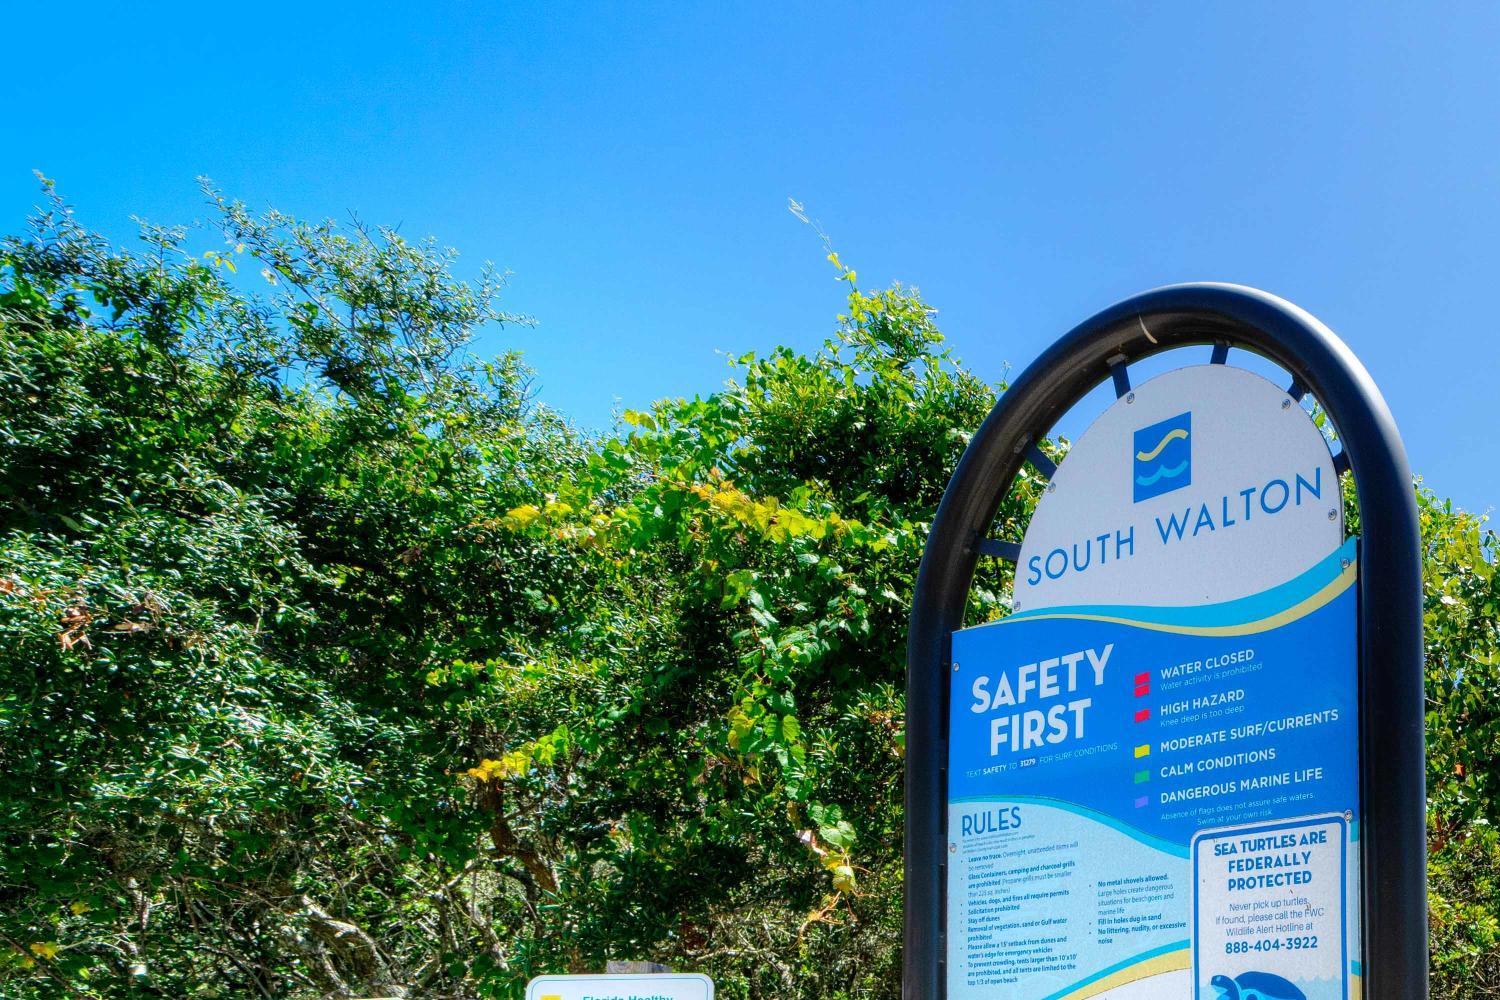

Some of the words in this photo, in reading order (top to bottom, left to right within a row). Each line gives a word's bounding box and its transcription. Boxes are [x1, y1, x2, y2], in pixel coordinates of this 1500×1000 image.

[1028, 526, 1134, 586] SOUTH
[1155, 467, 1321, 544] WALTON
[1161, 661, 1201, 679] WATER
[1206, 649, 1254, 669] CLOSED
[970, 643, 1114, 713] SAFETY
[1160, 681, 1182, 690] Water
[1184, 674, 1211, 686] activity
[1214, 670, 1220, 679] is
[1161, 701, 1188, 715] HIGH
[1193, 689, 1245, 709] HAZARD
[991, 698, 1091, 756] FIRST
[1160, 718, 1179, 727] Knee
[1181, 713, 1199, 724] deep
[1210, 709, 1223, 718] too
[1161, 731, 1226, 752] MODERATE
[1230, 709, 1339, 740] SURF/CURRENTS
[966, 769, 981, 778] TEXT
[983, 765, 1007, 775] SAFETY
[1074, 743, 1118, 757] CONDITIONS
[1161, 762, 1193, 778] CALM
[1197, 748, 1276, 772] CONDITIONS
[1161, 782, 1236, 804] DANGEROUS
[1241, 773, 1290, 791] MARINE
[1295, 768, 1322, 782] LIFE
[1161, 811, 1188, 821] Absence
[1199, 806, 1215, 816] flags
[1217, 804, 1233, 813] does
[1235, 802, 1247, 810] not
[1273, 796, 1287, 804] safe
[1197, 816, 1215, 825] Swim
[1226, 813, 1241, 823] your
[1243, 811, 1258, 819] own
[962, 807, 1021, 836] RULES
[1214, 842, 1237, 856] SEA
[1241, 835, 1296, 852] TURTLES
[1299, 830, 1326, 846] ARE
[1229, 851, 1311, 873] FEDERALLY
[1228, 871, 1312, 891] PROTECTED
[995, 905, 1020, 913] prohibited
[1230, 903, 1250, 911] Never
[1254, 901, 1269, 911] pick
[1271, 901, 1281, 909] up
[1248, 912, 1273, 924] please
[1275, 911, 1288, 919] call
[1290, 910, 1302, 918] the
[1305, 908, 1324, 917] FWC
[1226, 927, 1254, 936] Wildlife
[1257, 925, 1274, 934] Alert
[1276, 923, 1304, 932] Hotline
[1226, 936, 1317, 954] 888-404-3922
